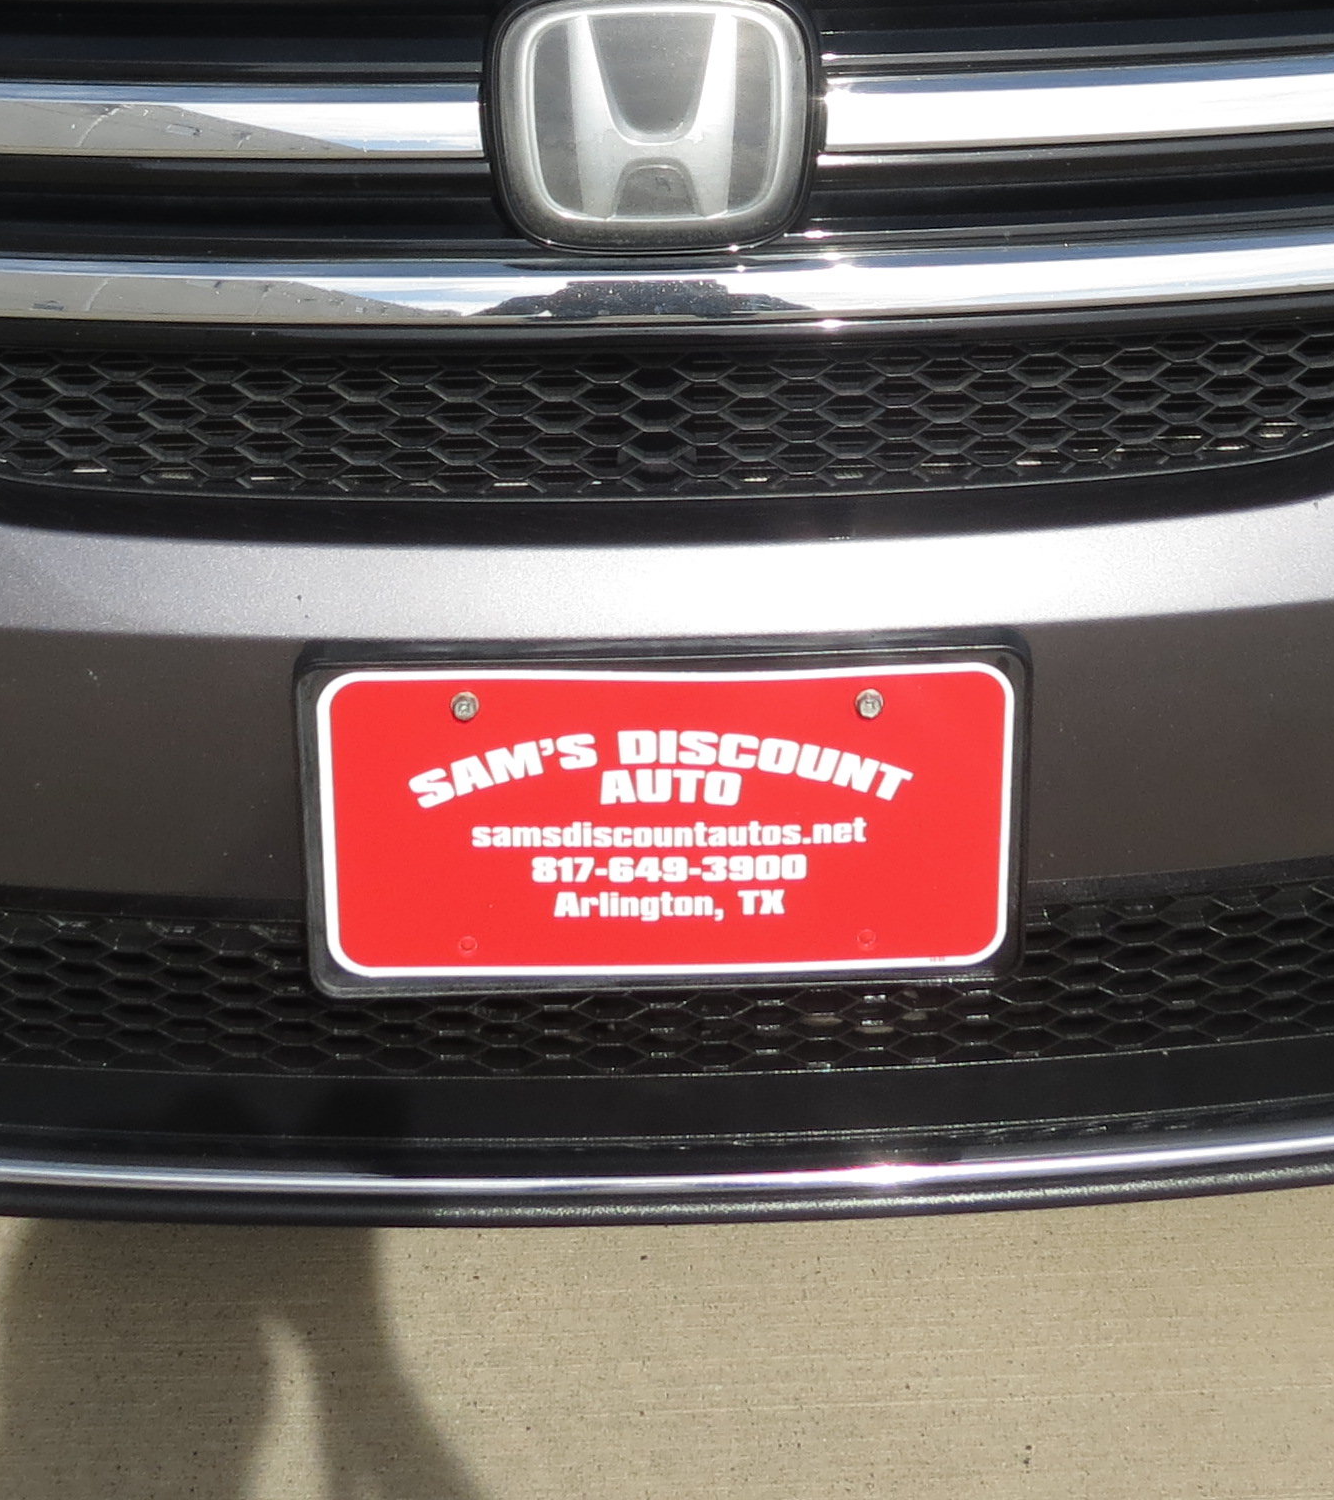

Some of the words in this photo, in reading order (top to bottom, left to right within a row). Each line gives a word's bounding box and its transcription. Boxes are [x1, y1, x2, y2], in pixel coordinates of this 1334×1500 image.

[408, 733, 598, 809] SAM'S
[617, 729, 914, 801] DISCOUNT
[600, 768, 743, 806] AUTO
[471, 816, 867, 848] samsdiscountautos.net
[531, 853, 808, 883] 817-649-3900
[553, 889, 725, 922] Arlington,
[737, 888, 785, 916] TX
